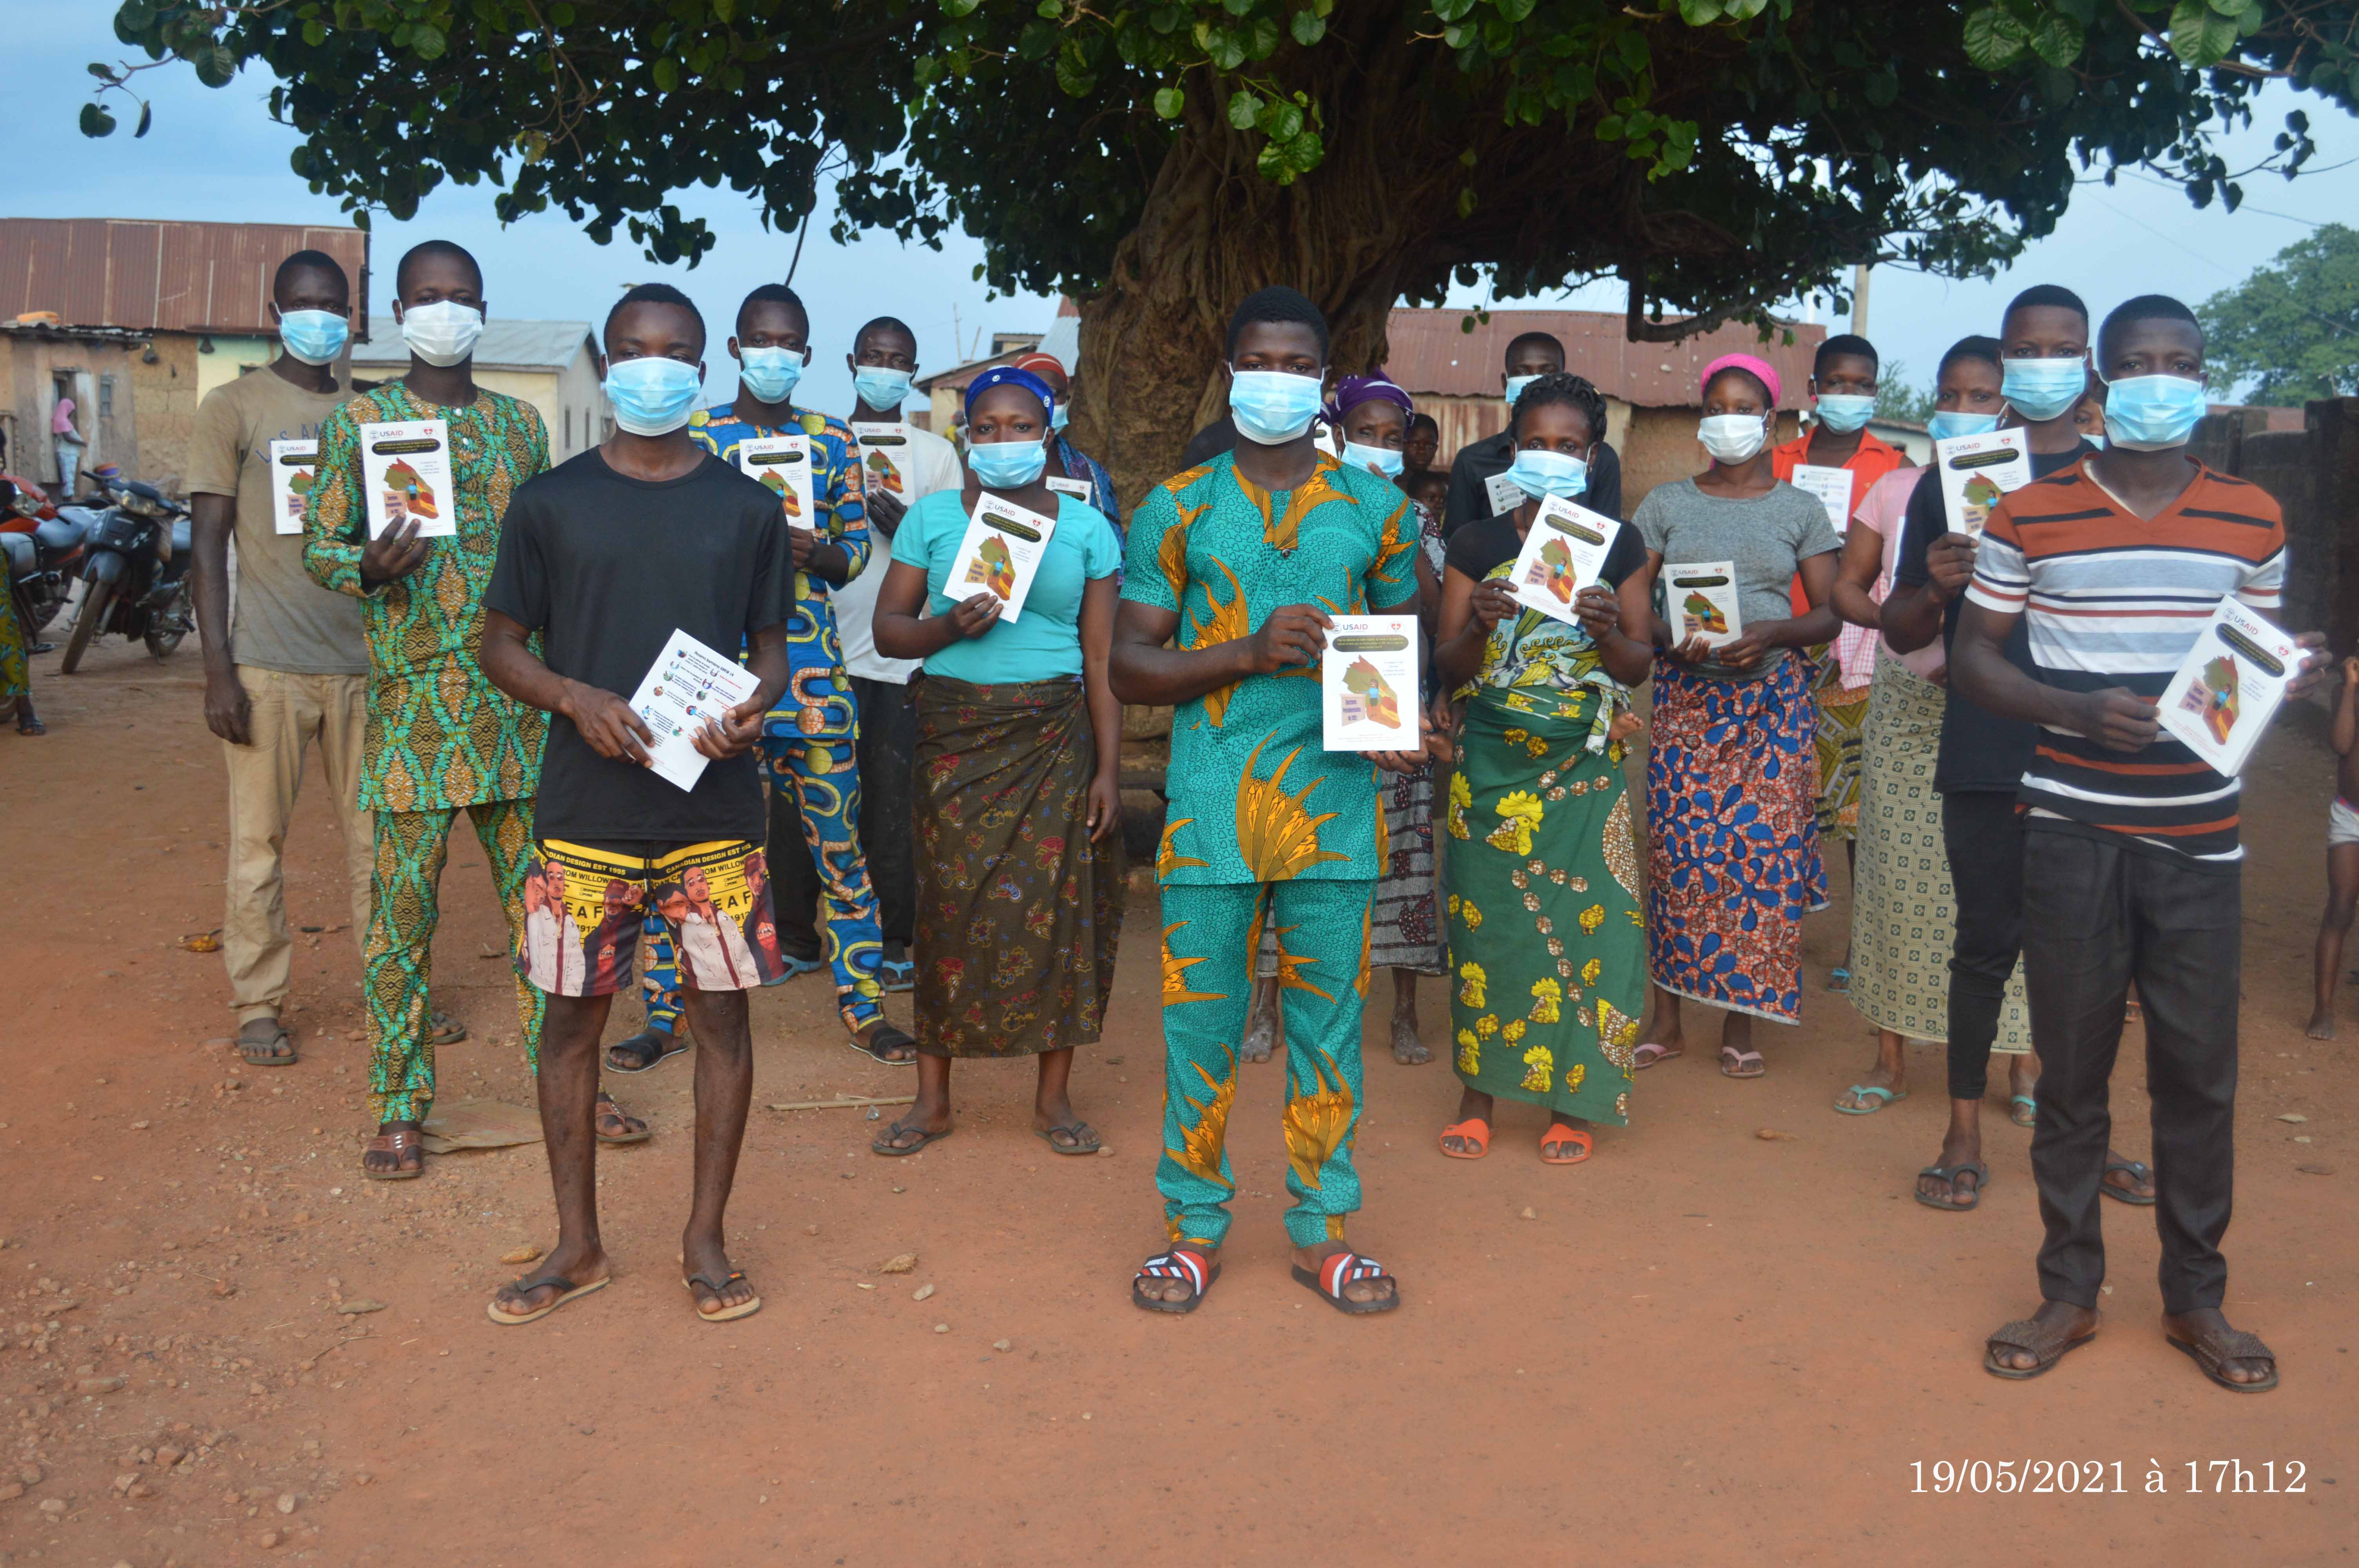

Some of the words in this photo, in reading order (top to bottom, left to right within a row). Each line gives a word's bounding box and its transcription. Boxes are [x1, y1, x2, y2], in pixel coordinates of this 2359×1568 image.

[1956, 443, 1980, 451] USAID
[995, 505, 1015, 516] USAID
[1559, 506, 1579, 518] USAID
[2234, 615, 2259, 635] USAID
[566, 857, 591, 868] DESIGN
[609, 867, 626, 875] 1995
[666, 858, 701, 874] CANADIAN
[702, 851, 726, 863] DESIGN
[727, 848, 740, 856] EST
[579, 874, 610, 884] WILLOW
